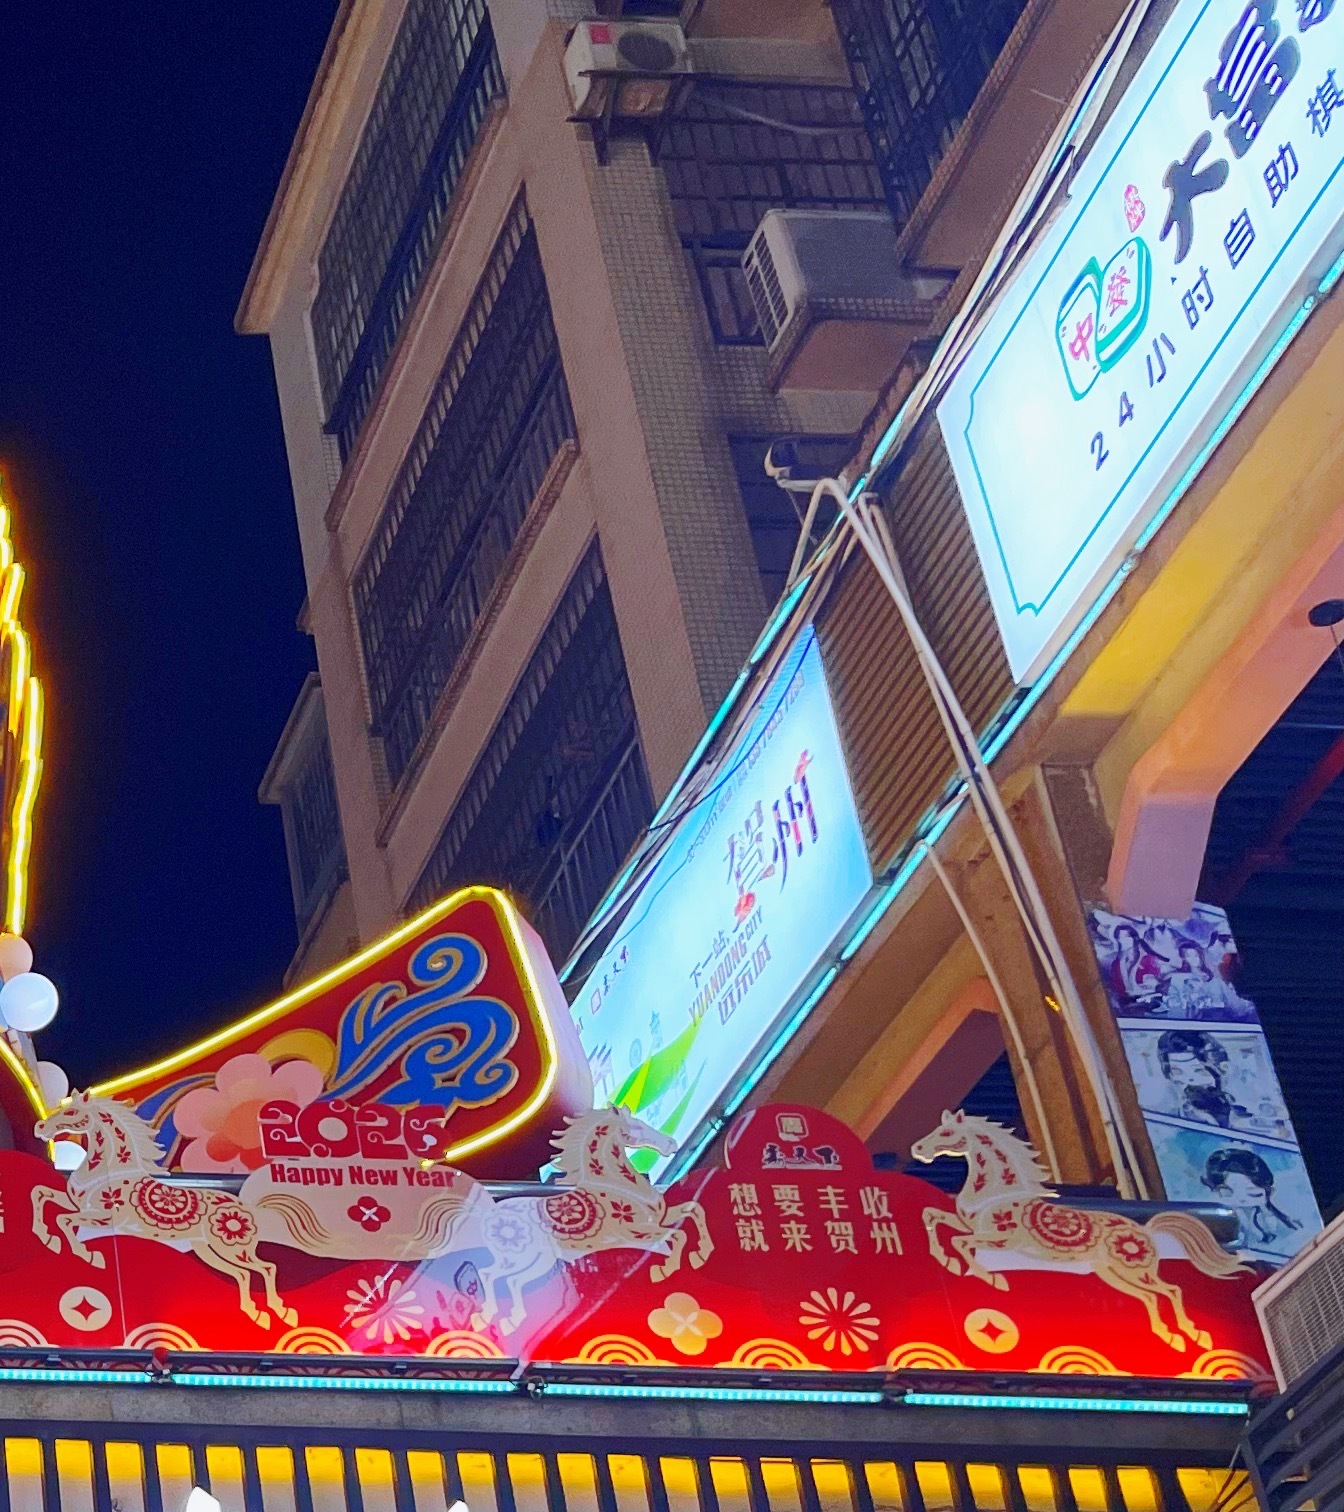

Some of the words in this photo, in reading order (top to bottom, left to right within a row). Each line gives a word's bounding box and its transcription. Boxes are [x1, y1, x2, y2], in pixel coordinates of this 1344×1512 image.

[259, 1099, 455, 1160] 2026
[269, 1163, 344, 1187] Happy
[349, 1165, 398, 1187] New
[403, 1166, 455, 1188] Year
[728, 1182, 894, 1220] 想要丰收
[735, 1219, 904, 1255] 就来贺州
